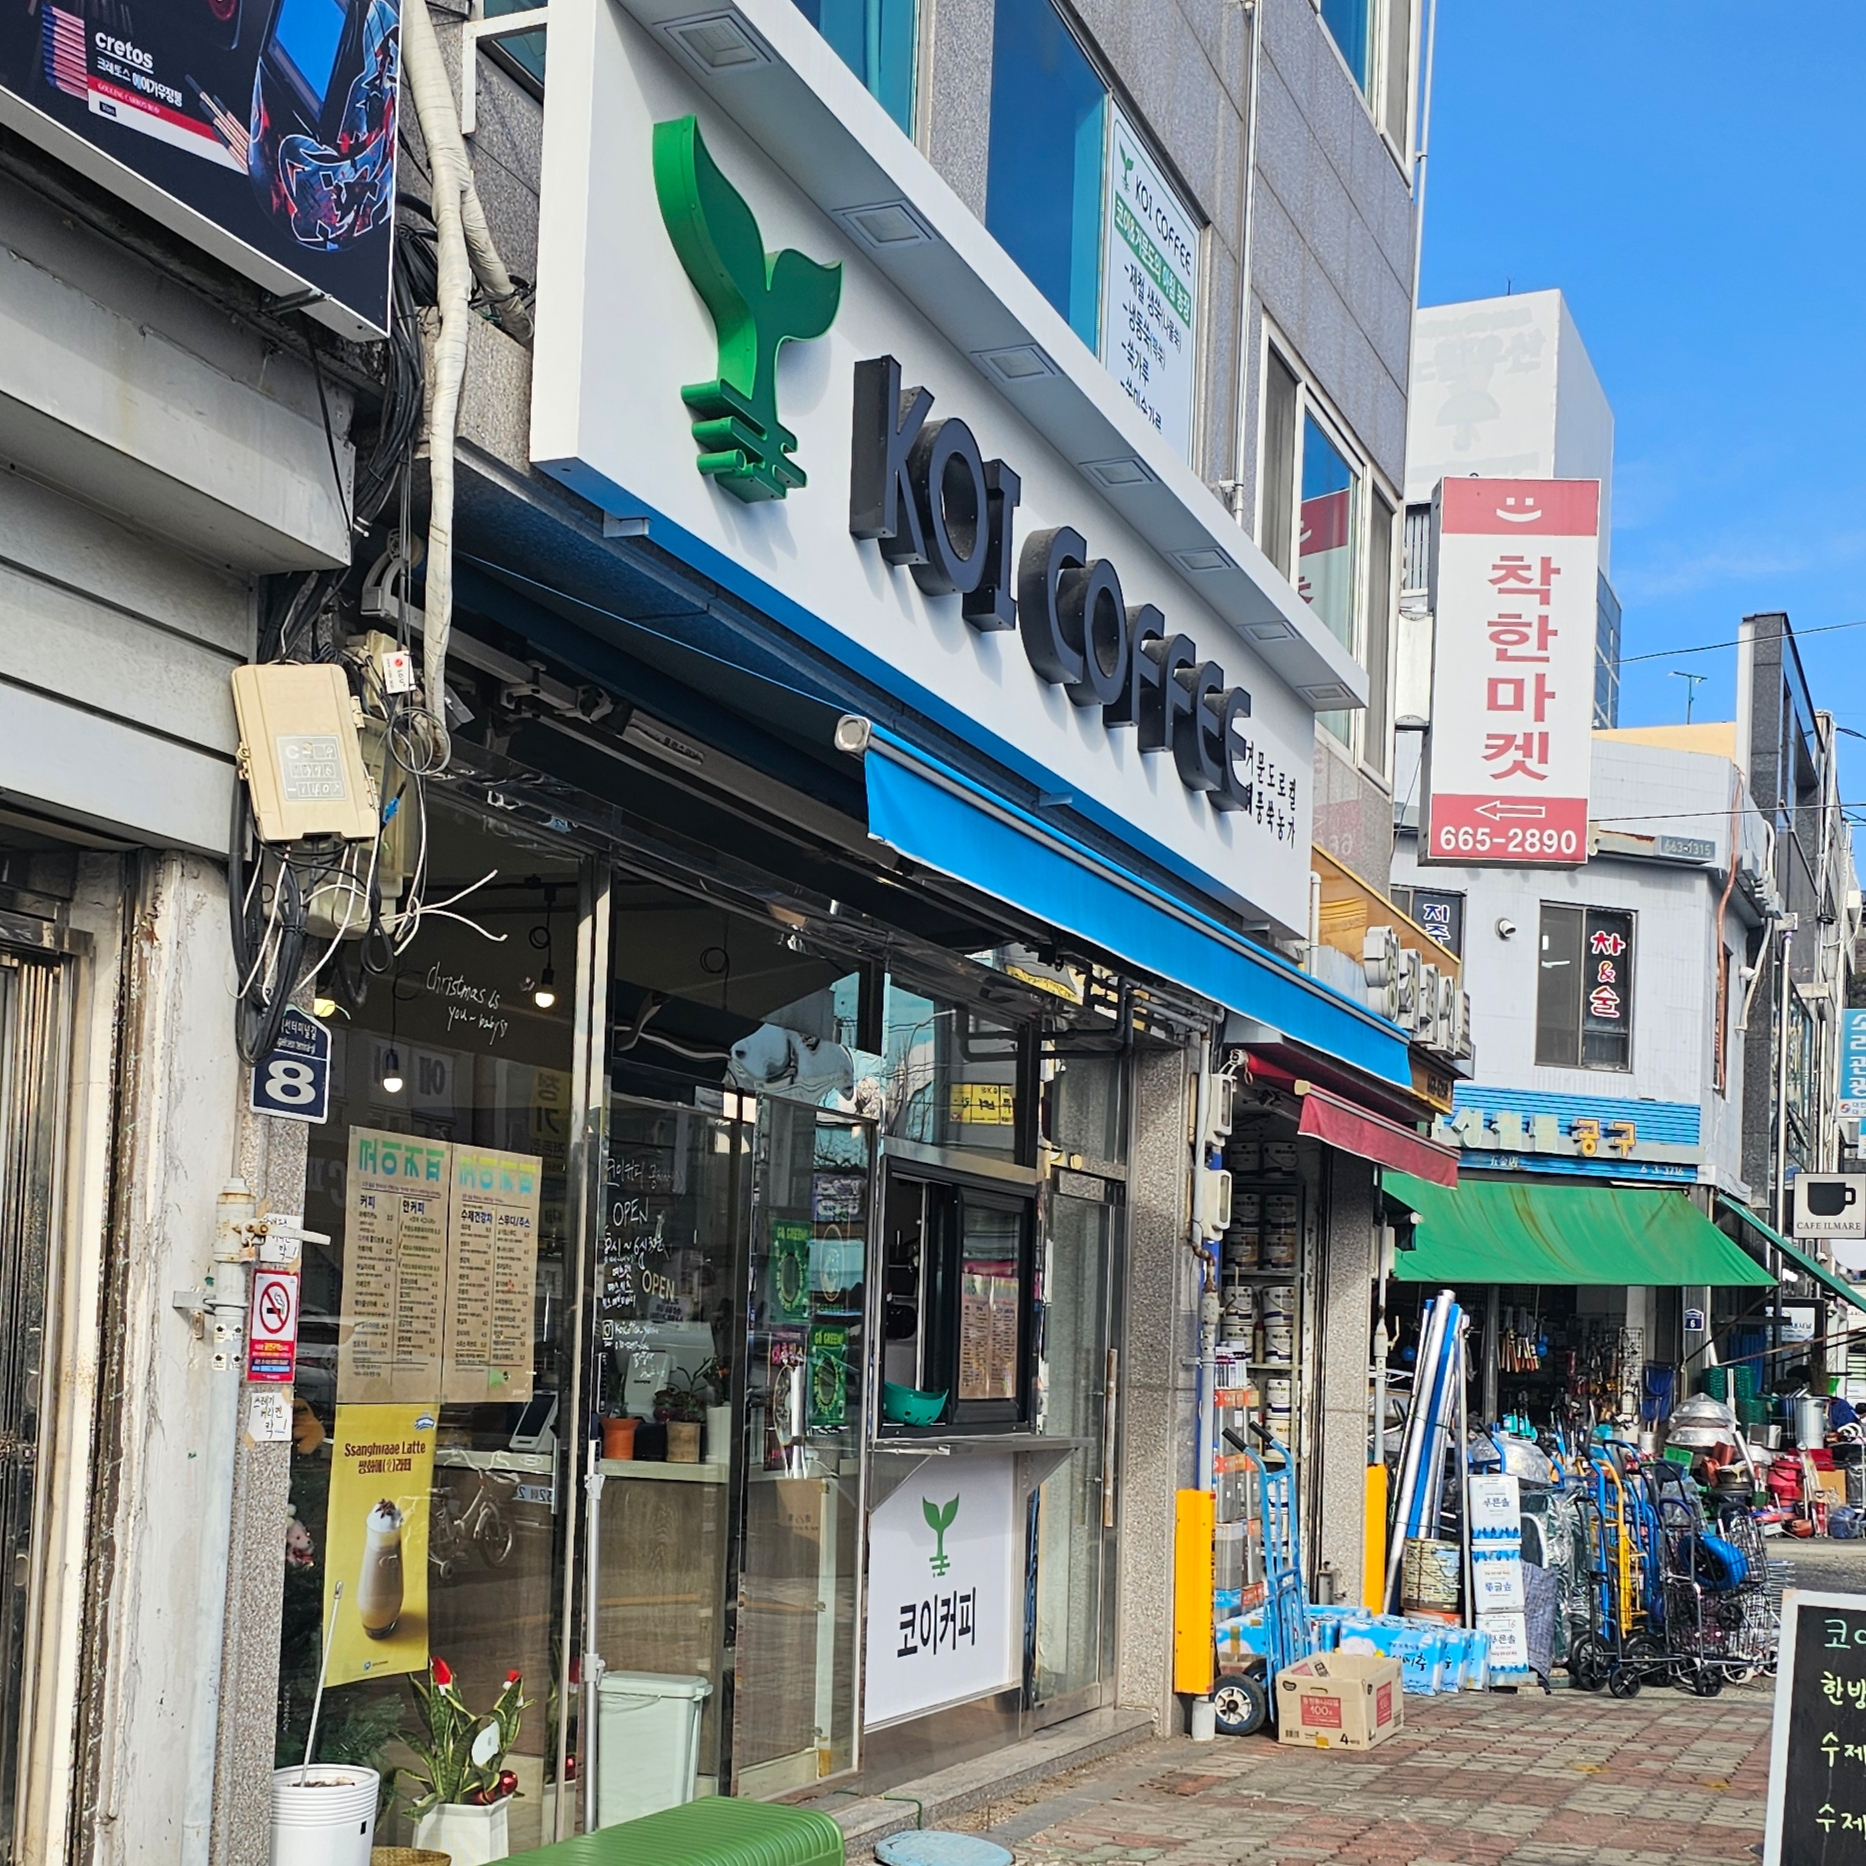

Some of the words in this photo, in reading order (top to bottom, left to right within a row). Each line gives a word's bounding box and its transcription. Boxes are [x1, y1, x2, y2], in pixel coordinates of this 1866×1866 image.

[95, 32, 153, 69] cretos
[1156, 208, 1192, 277] COFFEE
[849, 354, 1021, 633] KOI
[1018, 525, 1252, 813] COFFEE
[1481, 555, 1561, 782] 착한마켓
[1440, 826, 1578, 855] 665-2890
[426, 961, 486, 1004] Christmas
[460, 1210, 493, 1226] 수제건강차
[498, 1216, 531, 1229] 스무디/주스
[612, 1197, 649, 1227] OPEN
[1796, 1221, 1821, 1231] CAFE
[1823, 1221, 1861, 1231] ILMARE
[642, 1269, 675, 1301] OPEN
[401, 1440, 426, 1455] Latte
[897, 1586, 976, 1658] 코이커피
